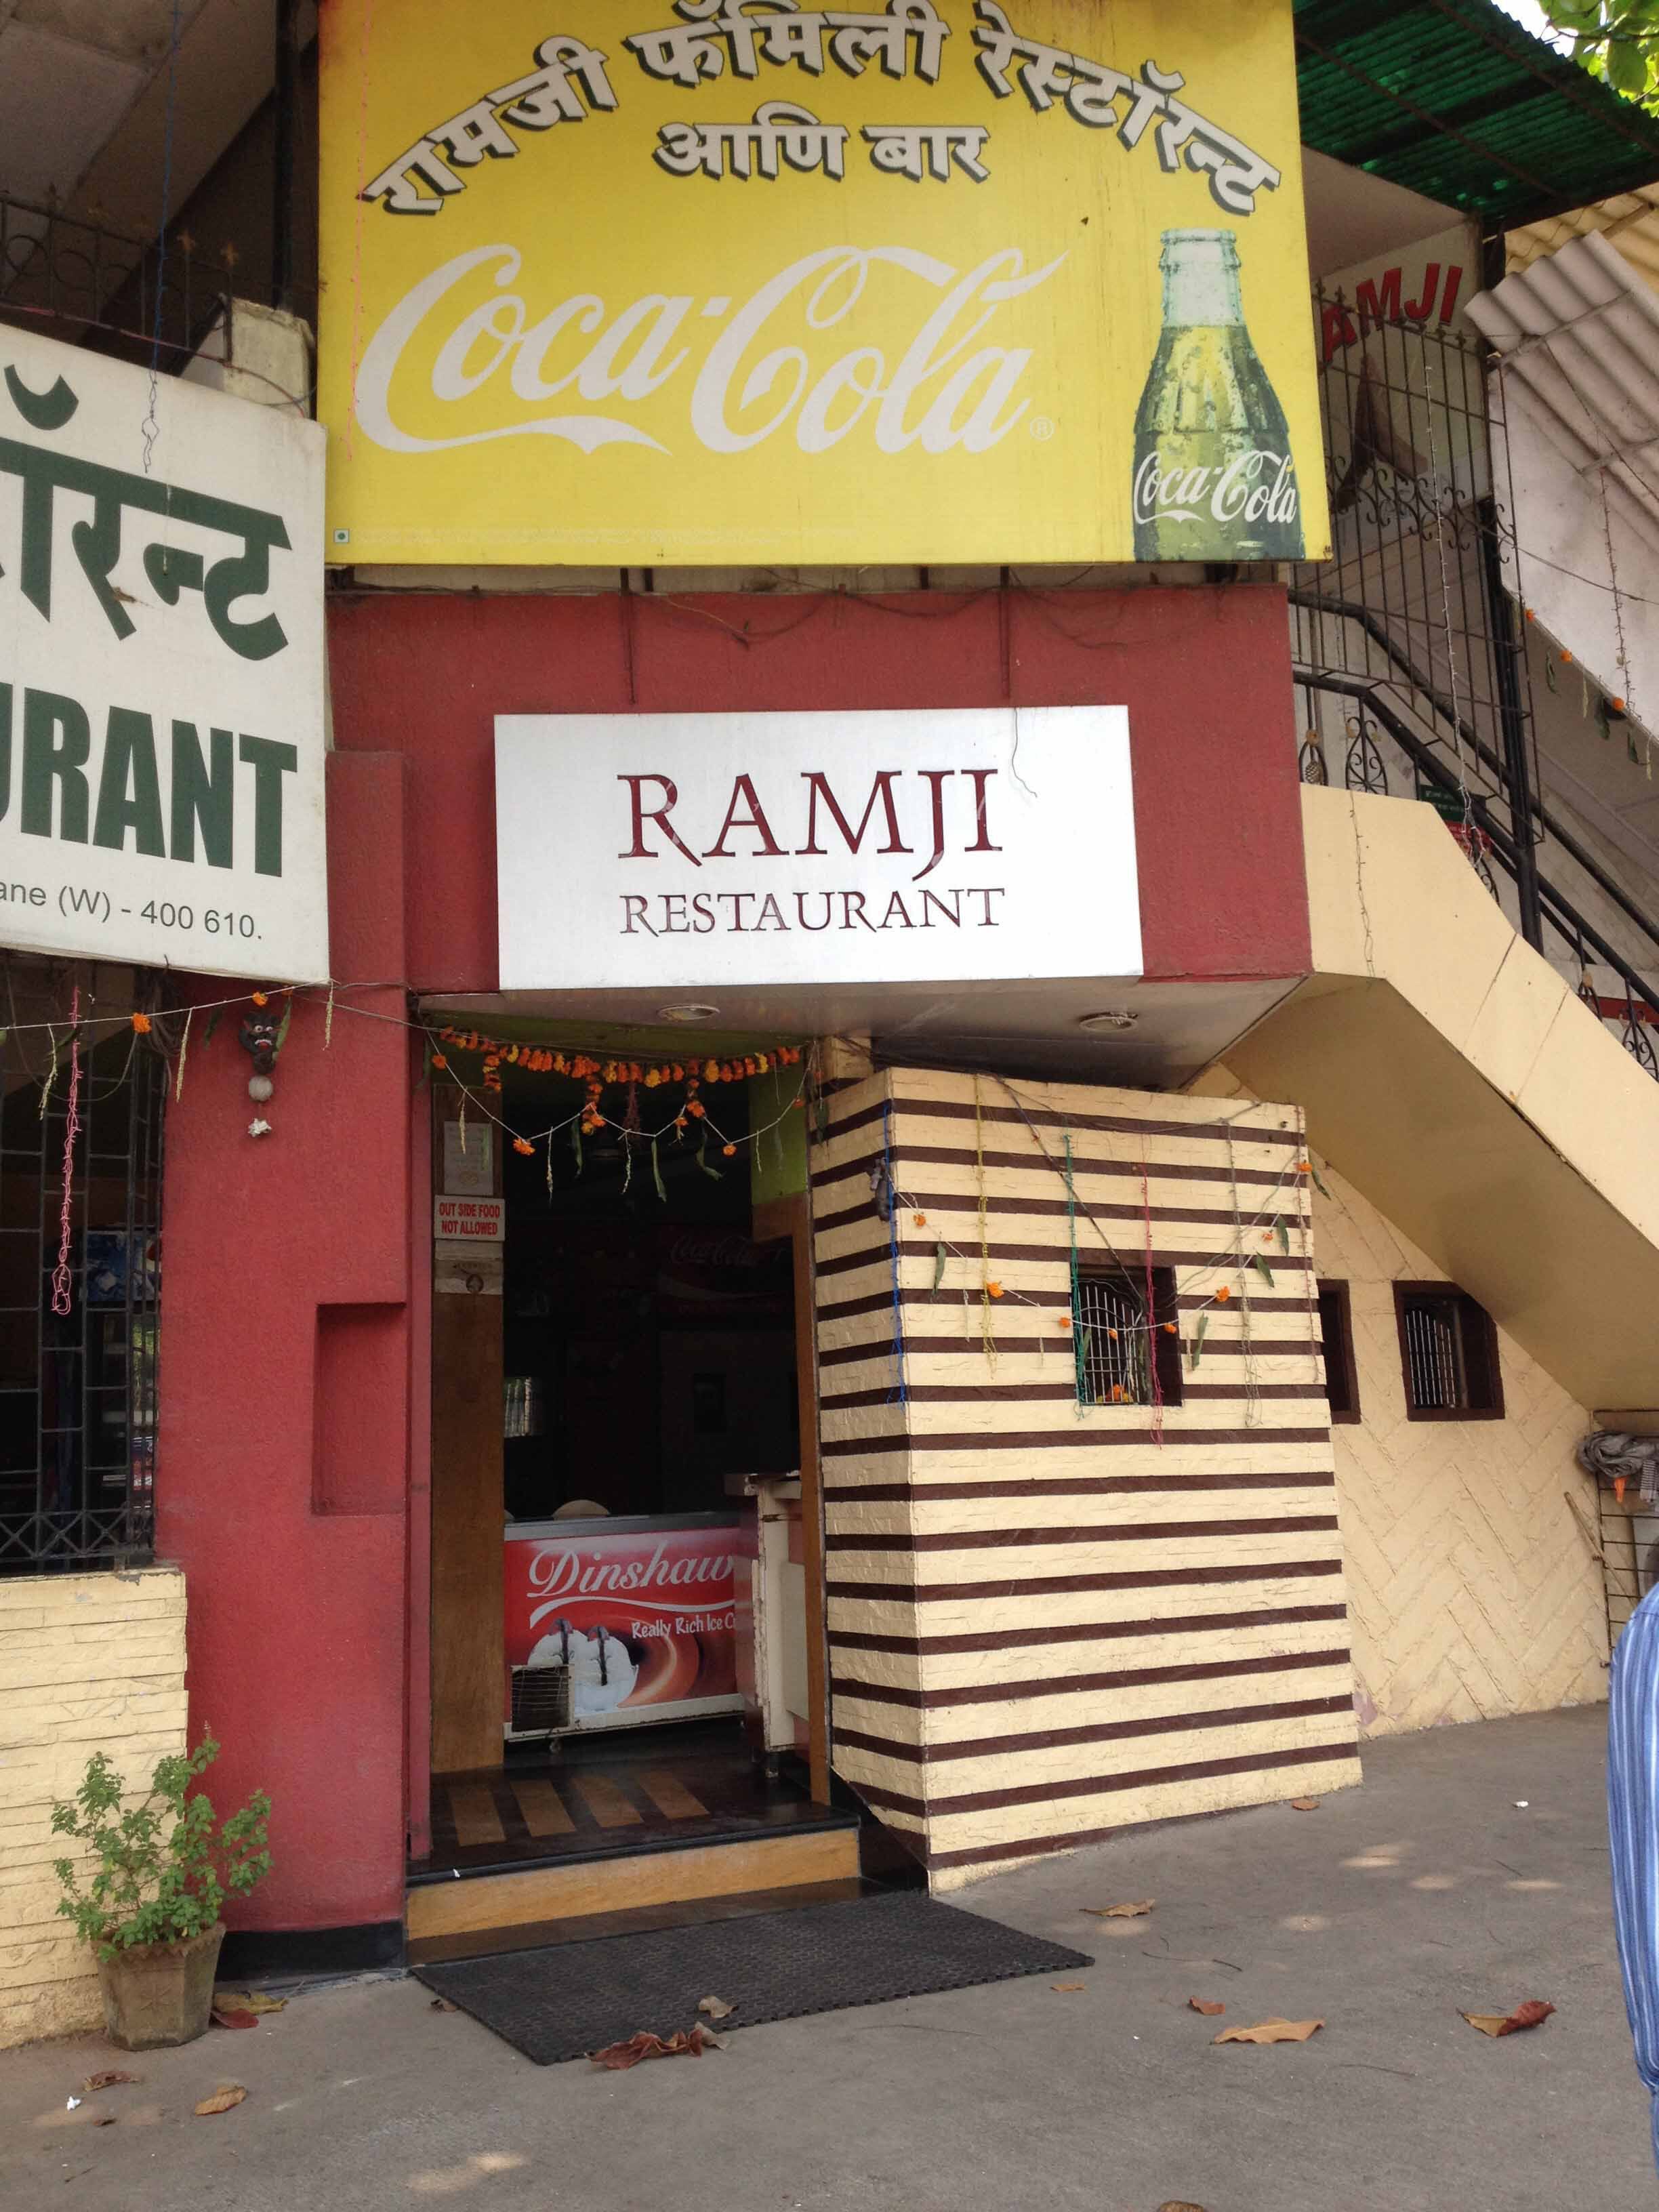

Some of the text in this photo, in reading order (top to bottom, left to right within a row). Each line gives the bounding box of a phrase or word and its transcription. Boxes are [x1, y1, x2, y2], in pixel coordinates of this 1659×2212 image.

[356, 35, 619, 216] रामजी
[653, 101, 990, 184] आणि बार
[354, 243, 1071, 456] Coca-Cola
[1322, 262, 1463, 367] AMJI
[1134, 450, 1298, 525] Coca-Cola
[0, 682, 298, 878] RANT
[617, 769, 1003, 882] RAMJI
[58, 885, 110, 923] (W)
[140, 900, 194, 930] 400
[204, 909, 262, 940] 610.
[619, 887, 1005, 937] RESTAURANT
[439, 1202, 501, 1218] OUT SIDE FOOD
[441, 1220, 498, 1236] NOT ALLOWED
[631, 1619, 671, 1639] Really
[676, 1616, 704, 1635] Rich
[707, 1616, 723, 1632] Ice
